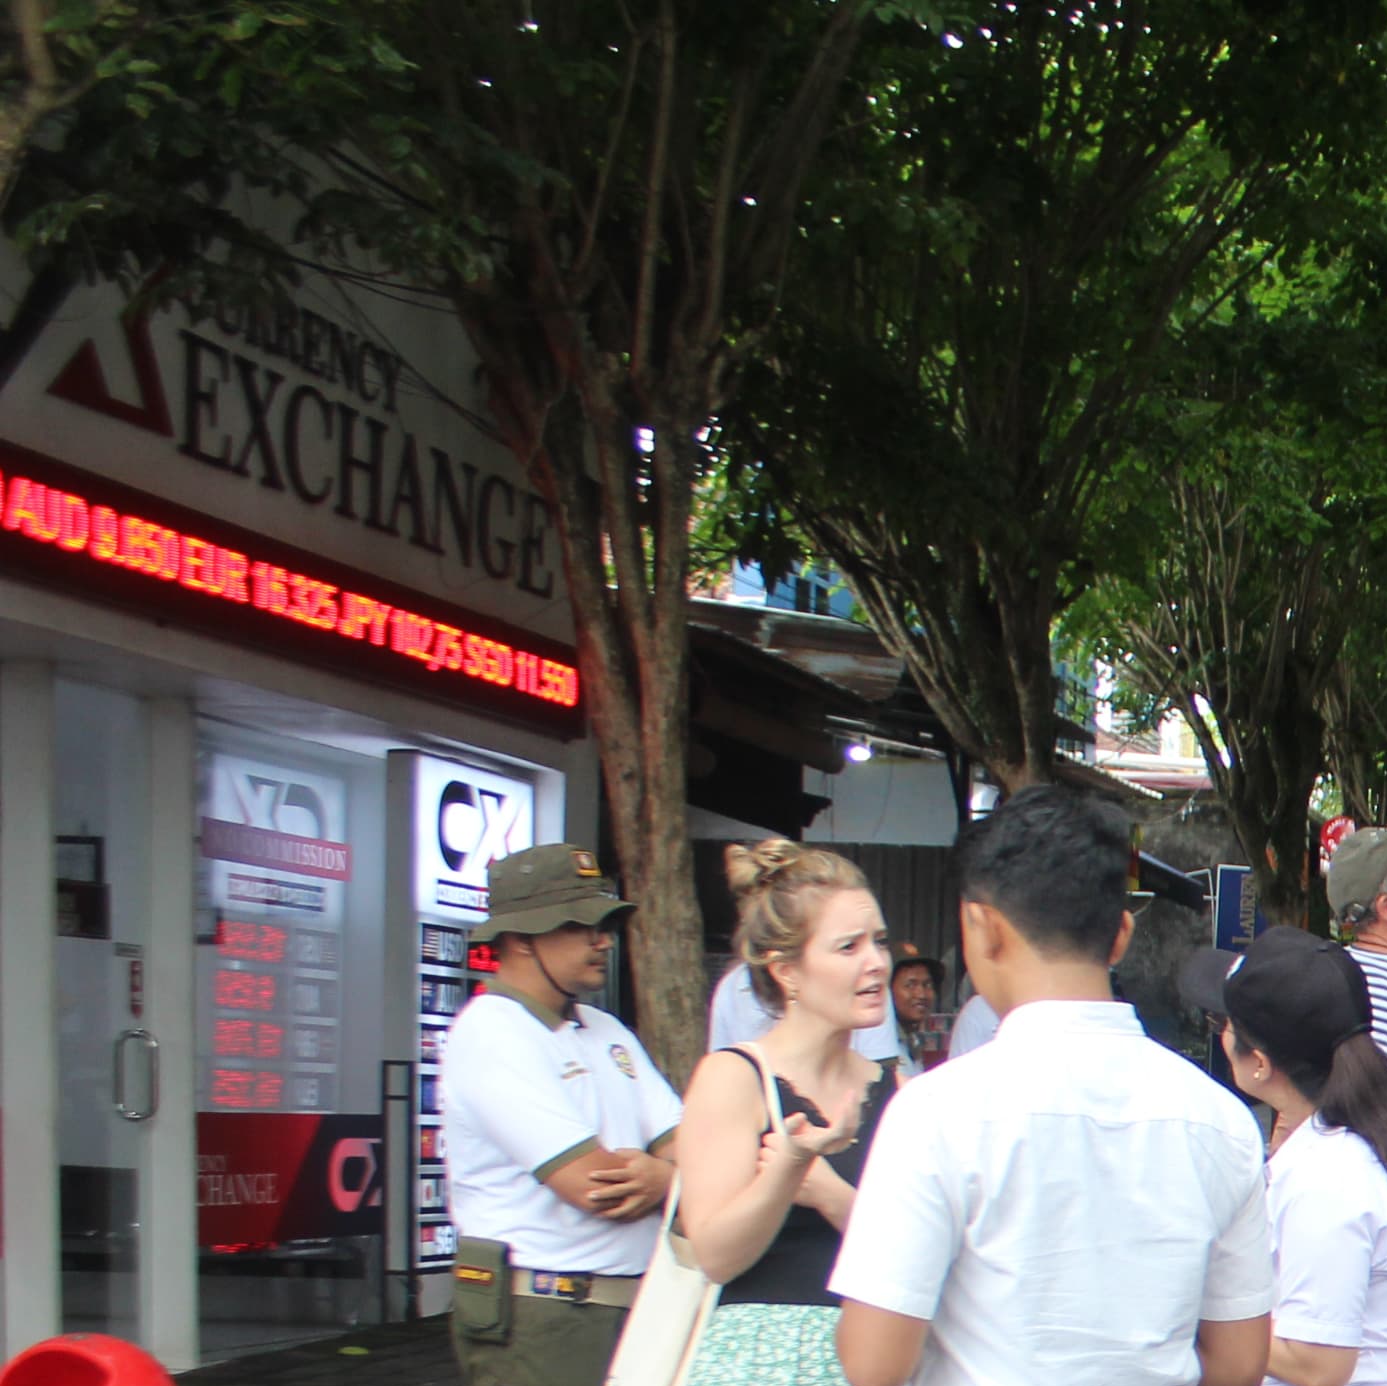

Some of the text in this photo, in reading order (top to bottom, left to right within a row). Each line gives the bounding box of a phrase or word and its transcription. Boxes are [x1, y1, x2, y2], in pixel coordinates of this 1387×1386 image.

[3, 476, 89, 552] AUD
[178, 534, 249, 603] EUR
[179, 329, 555, 599] EXCHANGE
